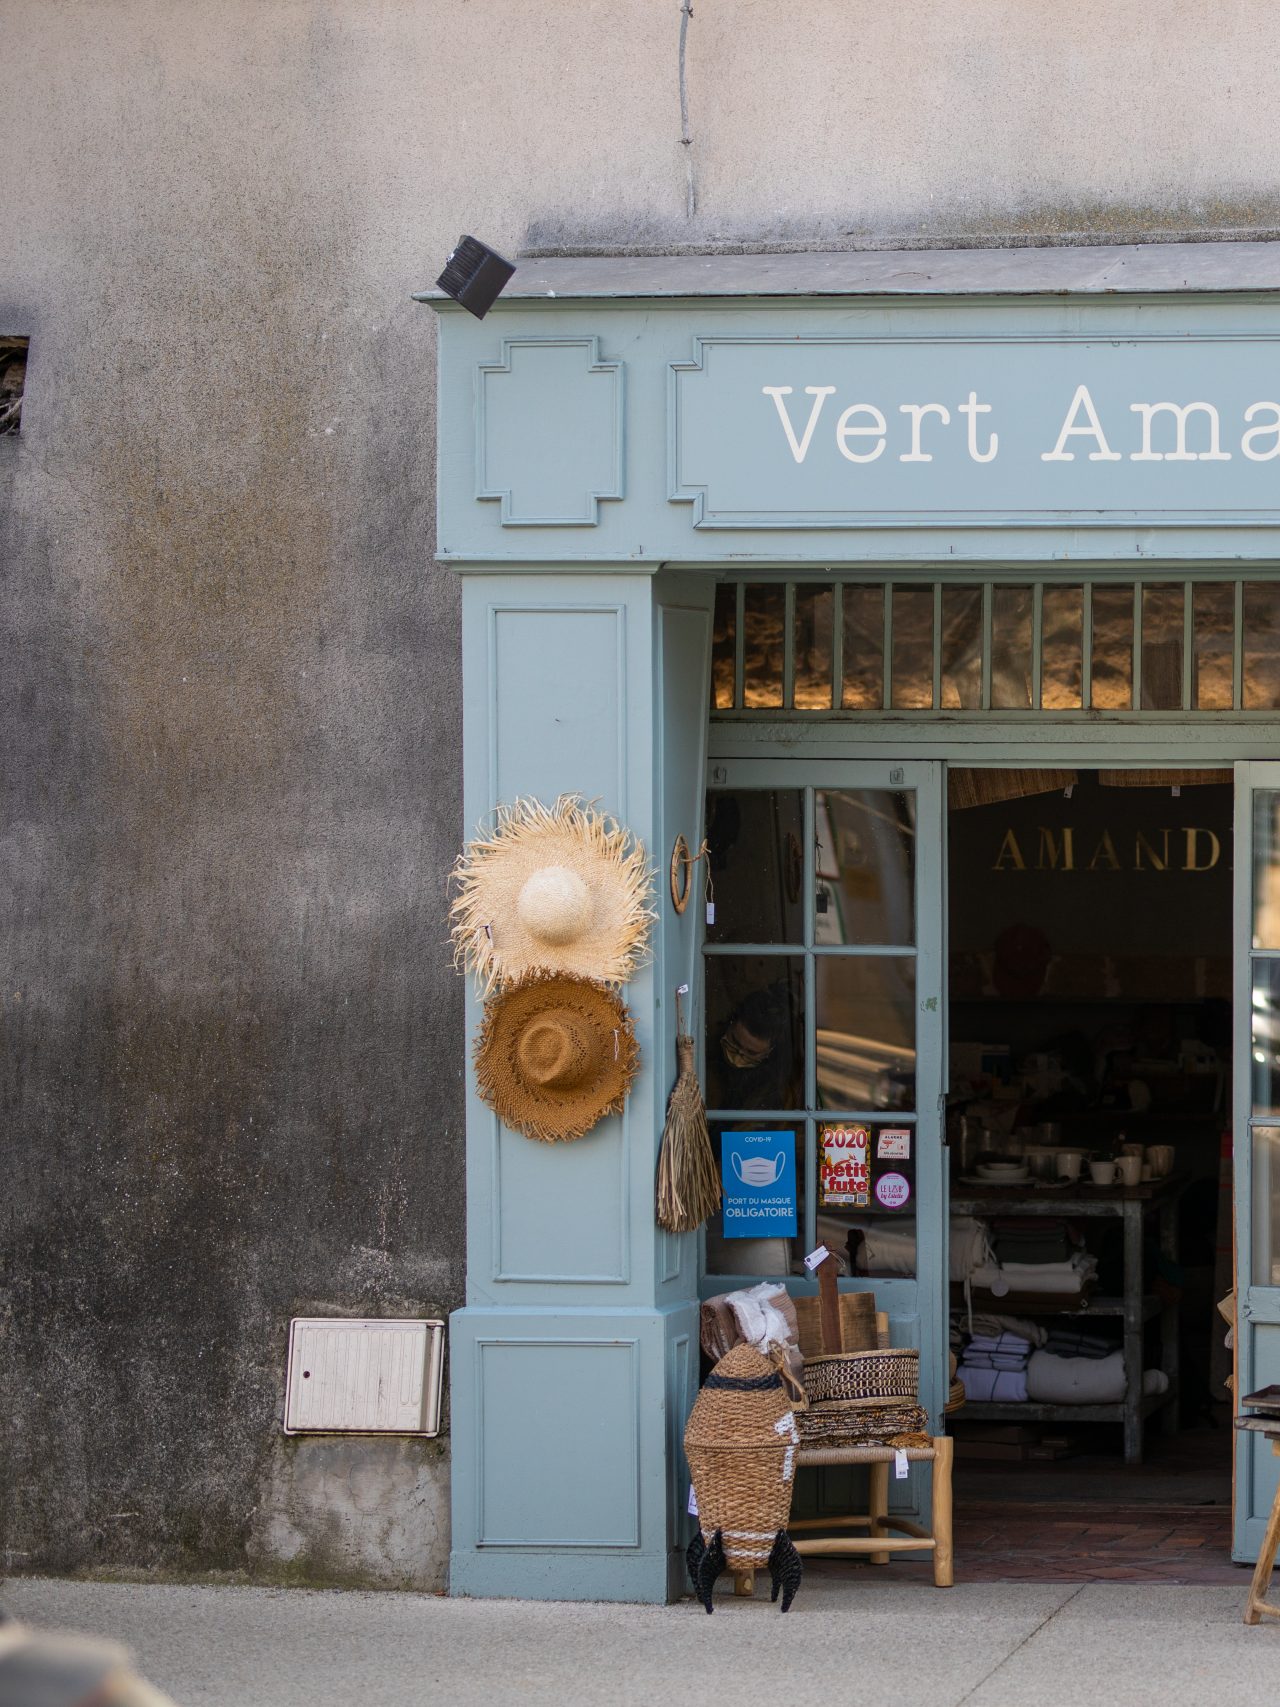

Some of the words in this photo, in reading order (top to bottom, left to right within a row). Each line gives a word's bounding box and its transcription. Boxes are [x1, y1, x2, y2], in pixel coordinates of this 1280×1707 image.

[762, 385, 999, 464] Vert
[991, 826, 1233, 871] AMAND
[823, 1128, 868, 1149] 2020
[821, 1161, 869, 1180] petit
[726, 1207, 794, 1218] OBLIGATOIRE
